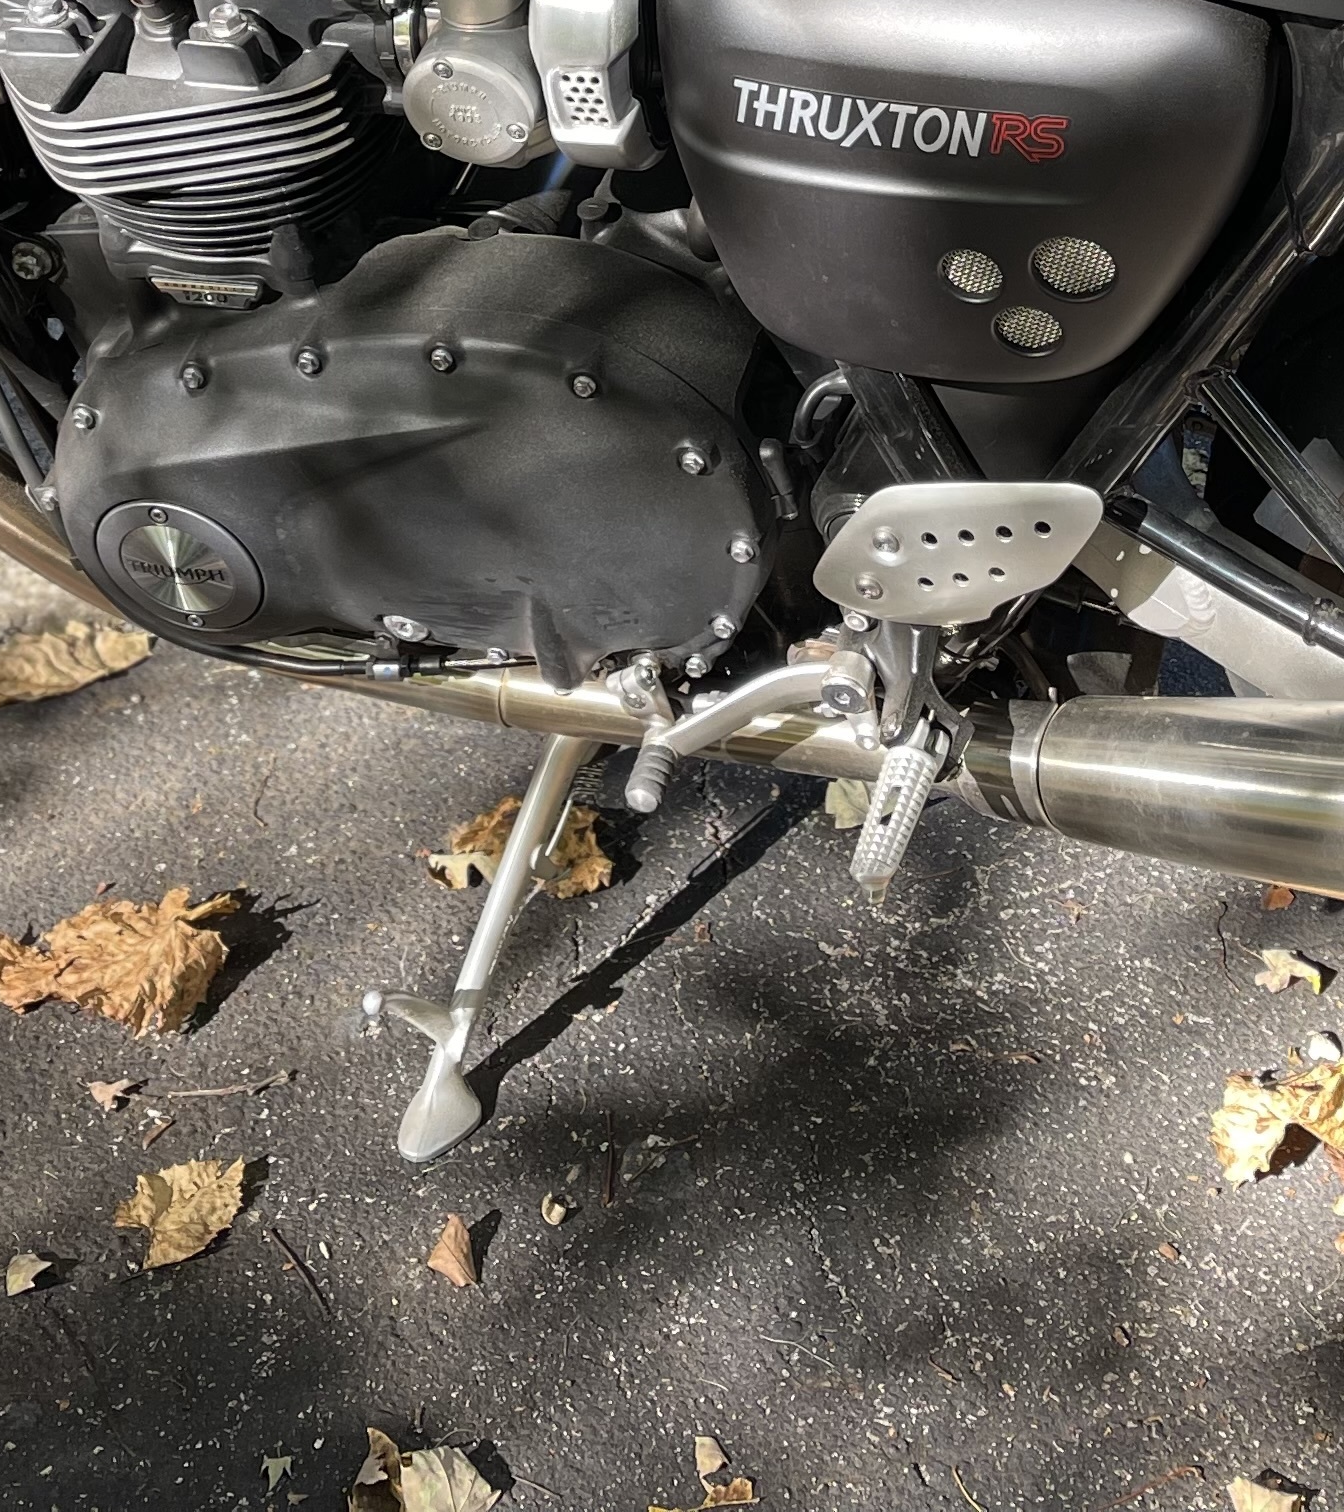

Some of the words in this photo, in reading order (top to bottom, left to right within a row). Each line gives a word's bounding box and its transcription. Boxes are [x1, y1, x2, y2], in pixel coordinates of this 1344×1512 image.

[734, 79, 987, 157] THRUXTON
[989, 113, 1069, 163] RS
[183, 291, 228, 303] 1200
[128, 559, 225, 585] TRIUMPH
